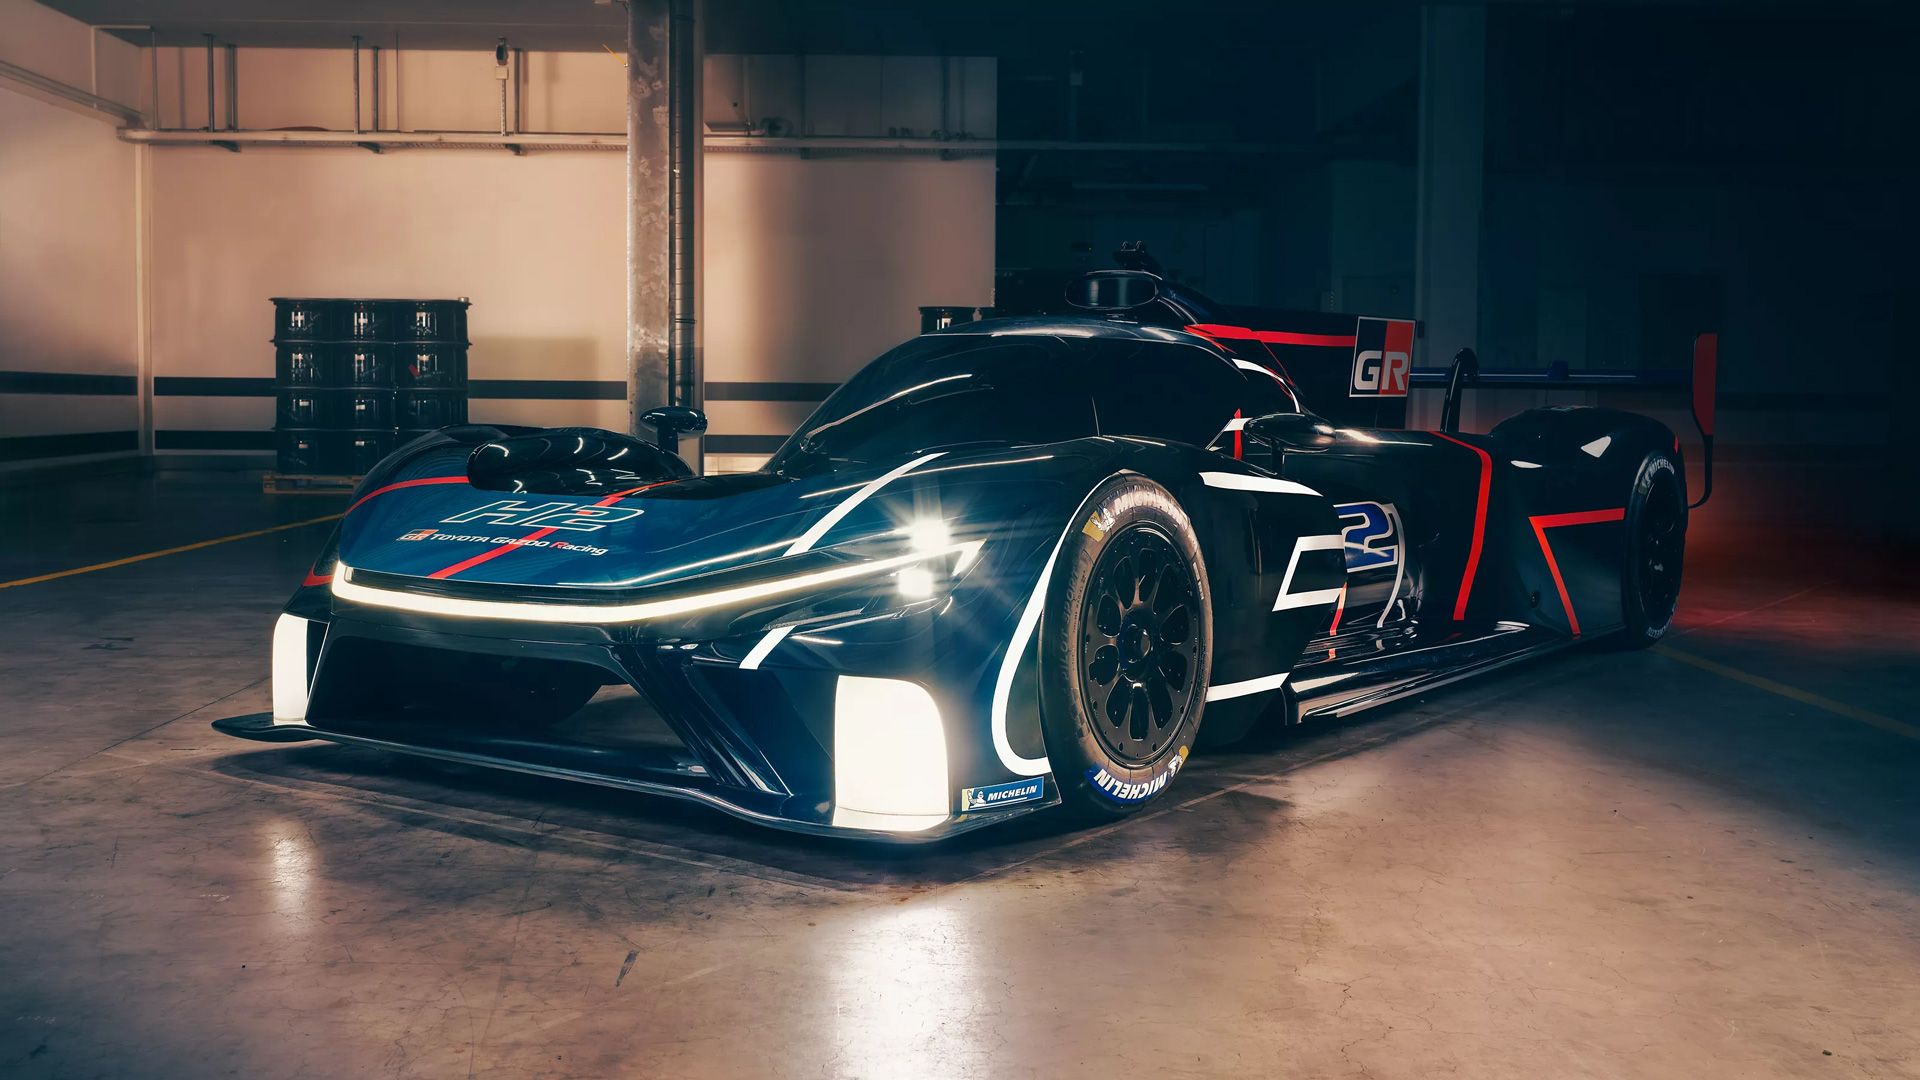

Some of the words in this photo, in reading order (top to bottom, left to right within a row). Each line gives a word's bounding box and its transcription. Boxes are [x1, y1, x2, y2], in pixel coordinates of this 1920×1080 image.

[1354, 350, 1409, 391] GR
[439, 500, 645, 532] H2
[430, 533, 491, 543] TOYOTA
[549, 541, 609, 556] Racing
[1333, 500, 1399, 574] 2
[987, 785, 1037, 801] MICHELIN
[1093, 768, 1168, 800] MICHELIN
